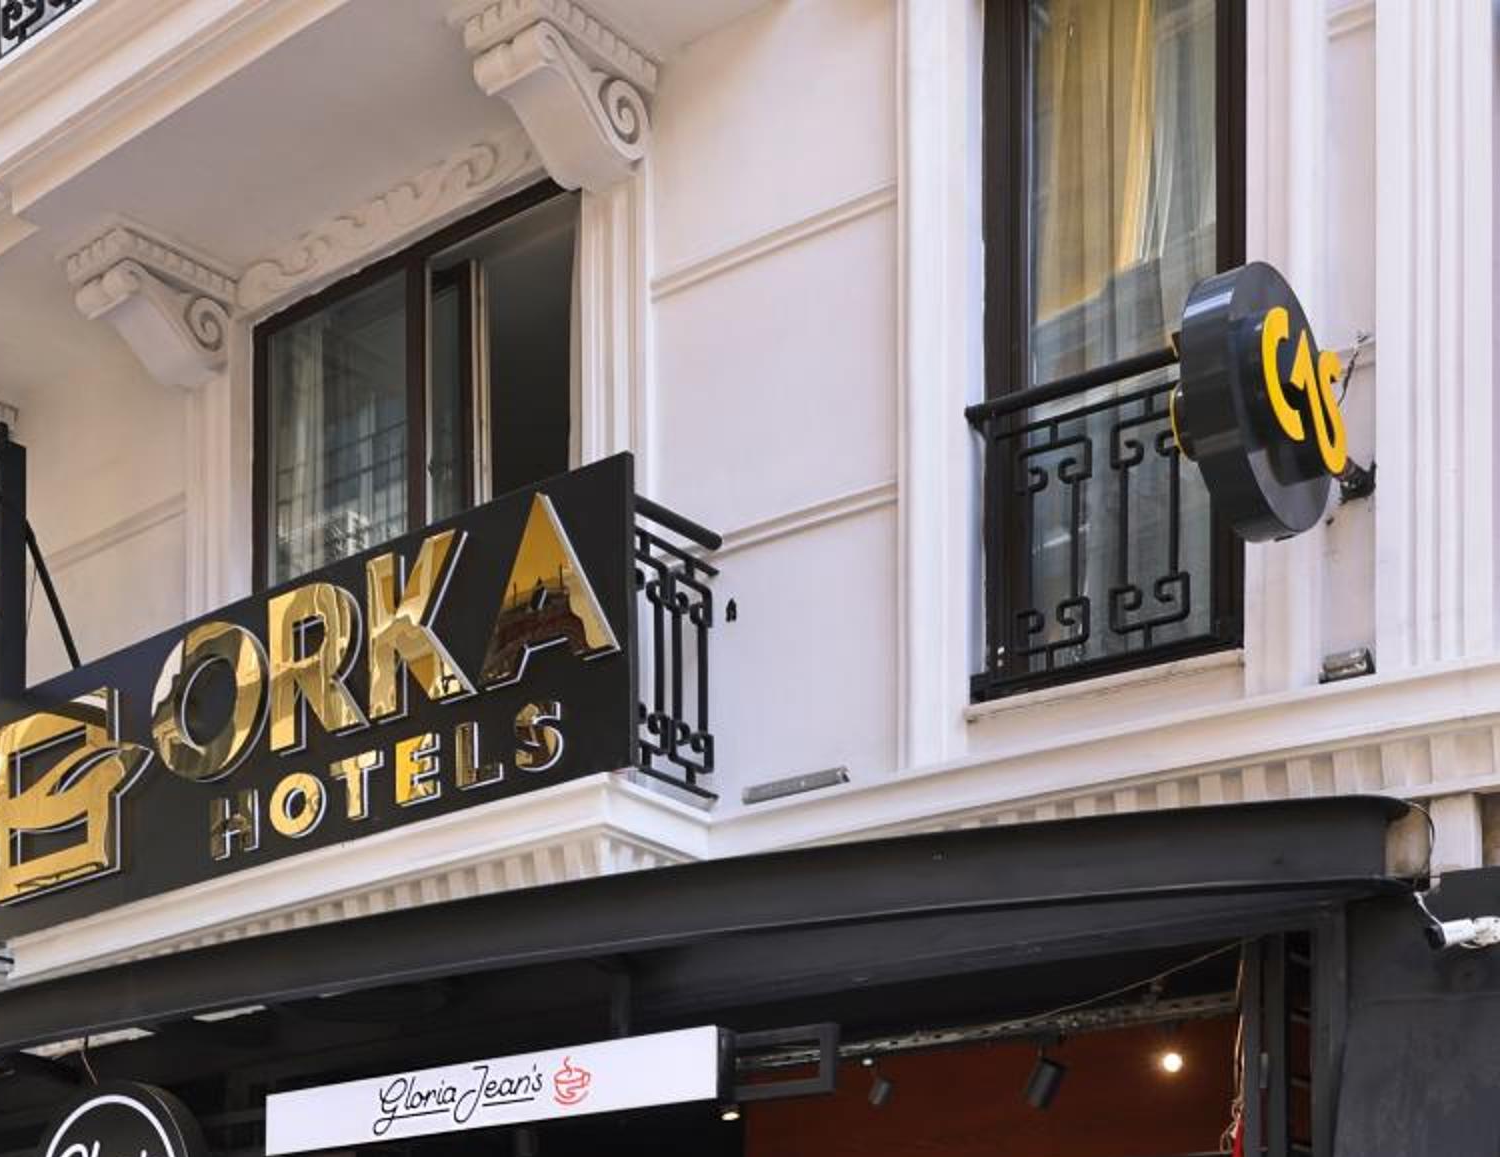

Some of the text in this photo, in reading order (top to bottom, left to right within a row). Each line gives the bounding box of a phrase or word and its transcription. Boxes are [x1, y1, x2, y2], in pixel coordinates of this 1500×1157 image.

[1262, 307, 1348, 474] CAS
[151, 491, 621, 783] ORKA
[211, 701, 564, 860] HOTELS
[372, 1064, 543, 1136] Gloria Jean's
